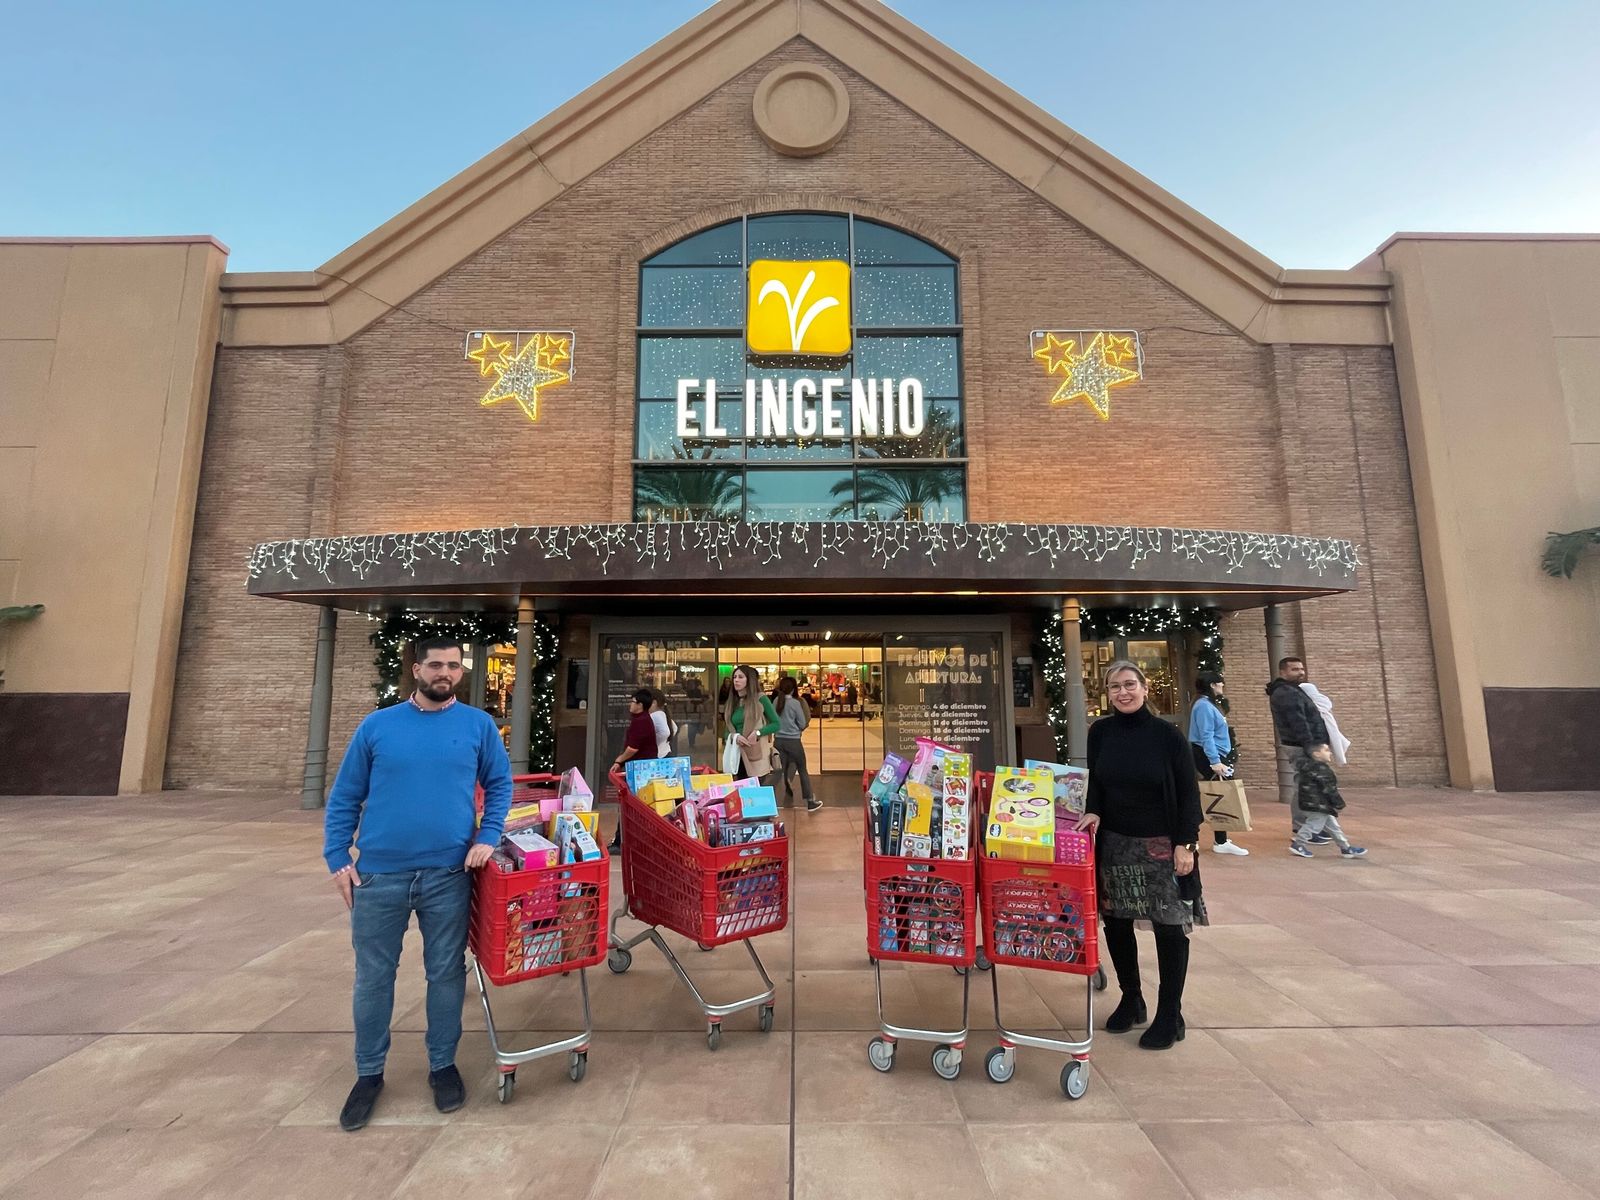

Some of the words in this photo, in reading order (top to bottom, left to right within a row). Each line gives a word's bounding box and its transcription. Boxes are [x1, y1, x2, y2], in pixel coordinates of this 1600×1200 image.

[676, 379, 727, 437] EL
[746, 377, 924, 438] INGENIO
[617, 652, 636, 660] LOS
[898, 654, 965, 667] FESTIVOS
[969, 654, 988, 666] DE
[905, 671, 982, 684] APERTURA:
[943, 734, 980, 742] diciembre
[1204, 792, 1240, 820] Z
